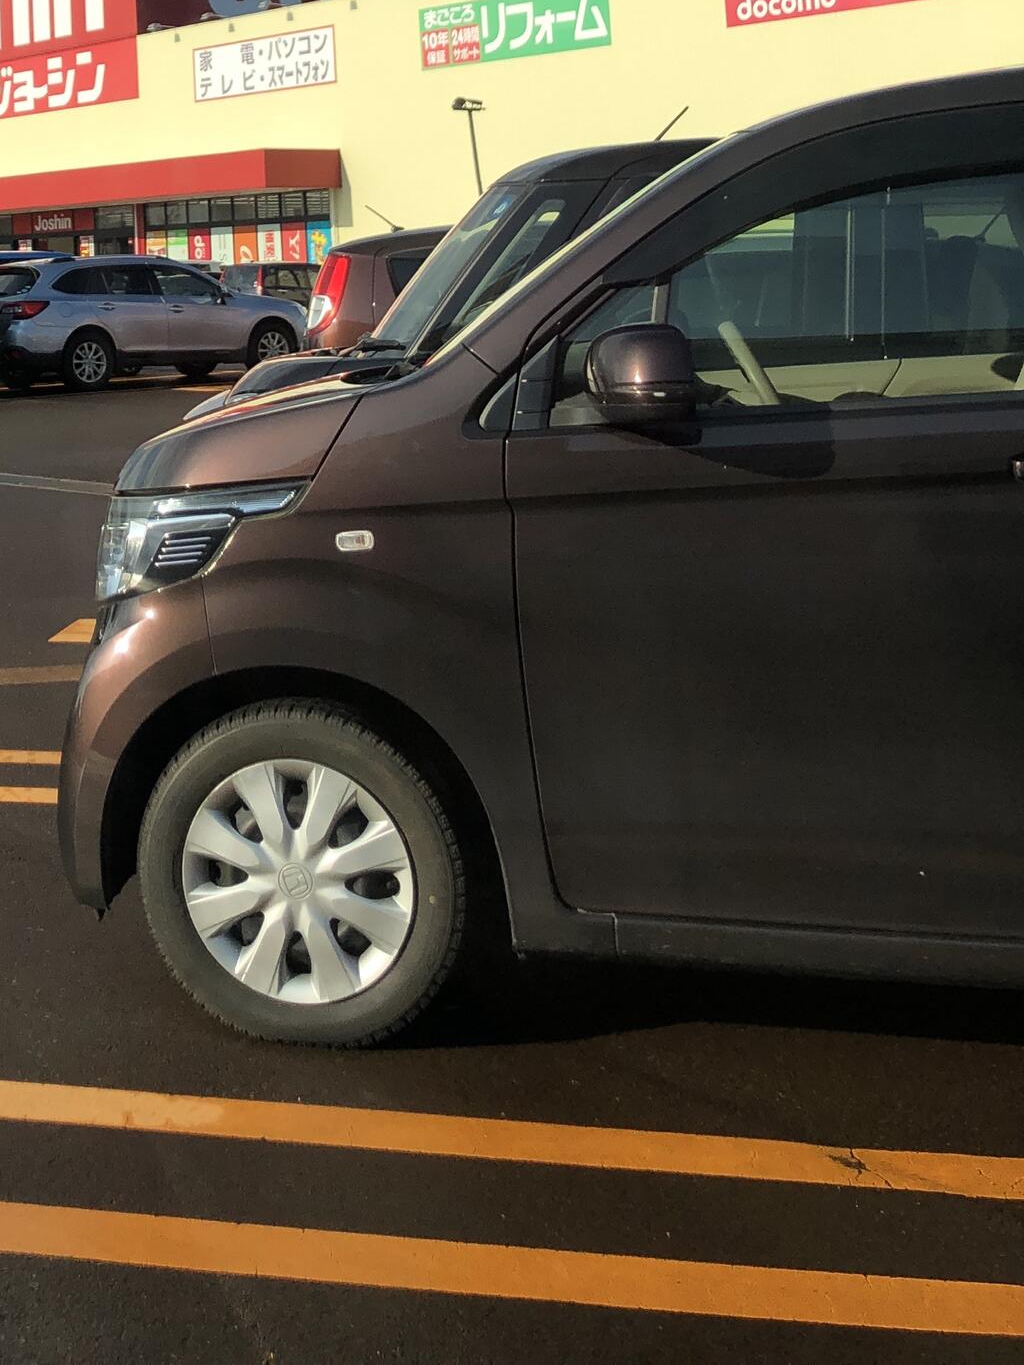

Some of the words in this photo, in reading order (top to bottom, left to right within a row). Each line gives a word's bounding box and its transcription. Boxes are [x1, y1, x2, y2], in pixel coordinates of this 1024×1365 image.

[423, 3, 475, 30] まごころ
[422, 29, 450, 51] 10年
[451, 24, 480, 47] 24時間
[426, 50, 447, 66] 保証
[452, 46, 481, 62] サポート
[34, 213, 73, 232] Joshin
